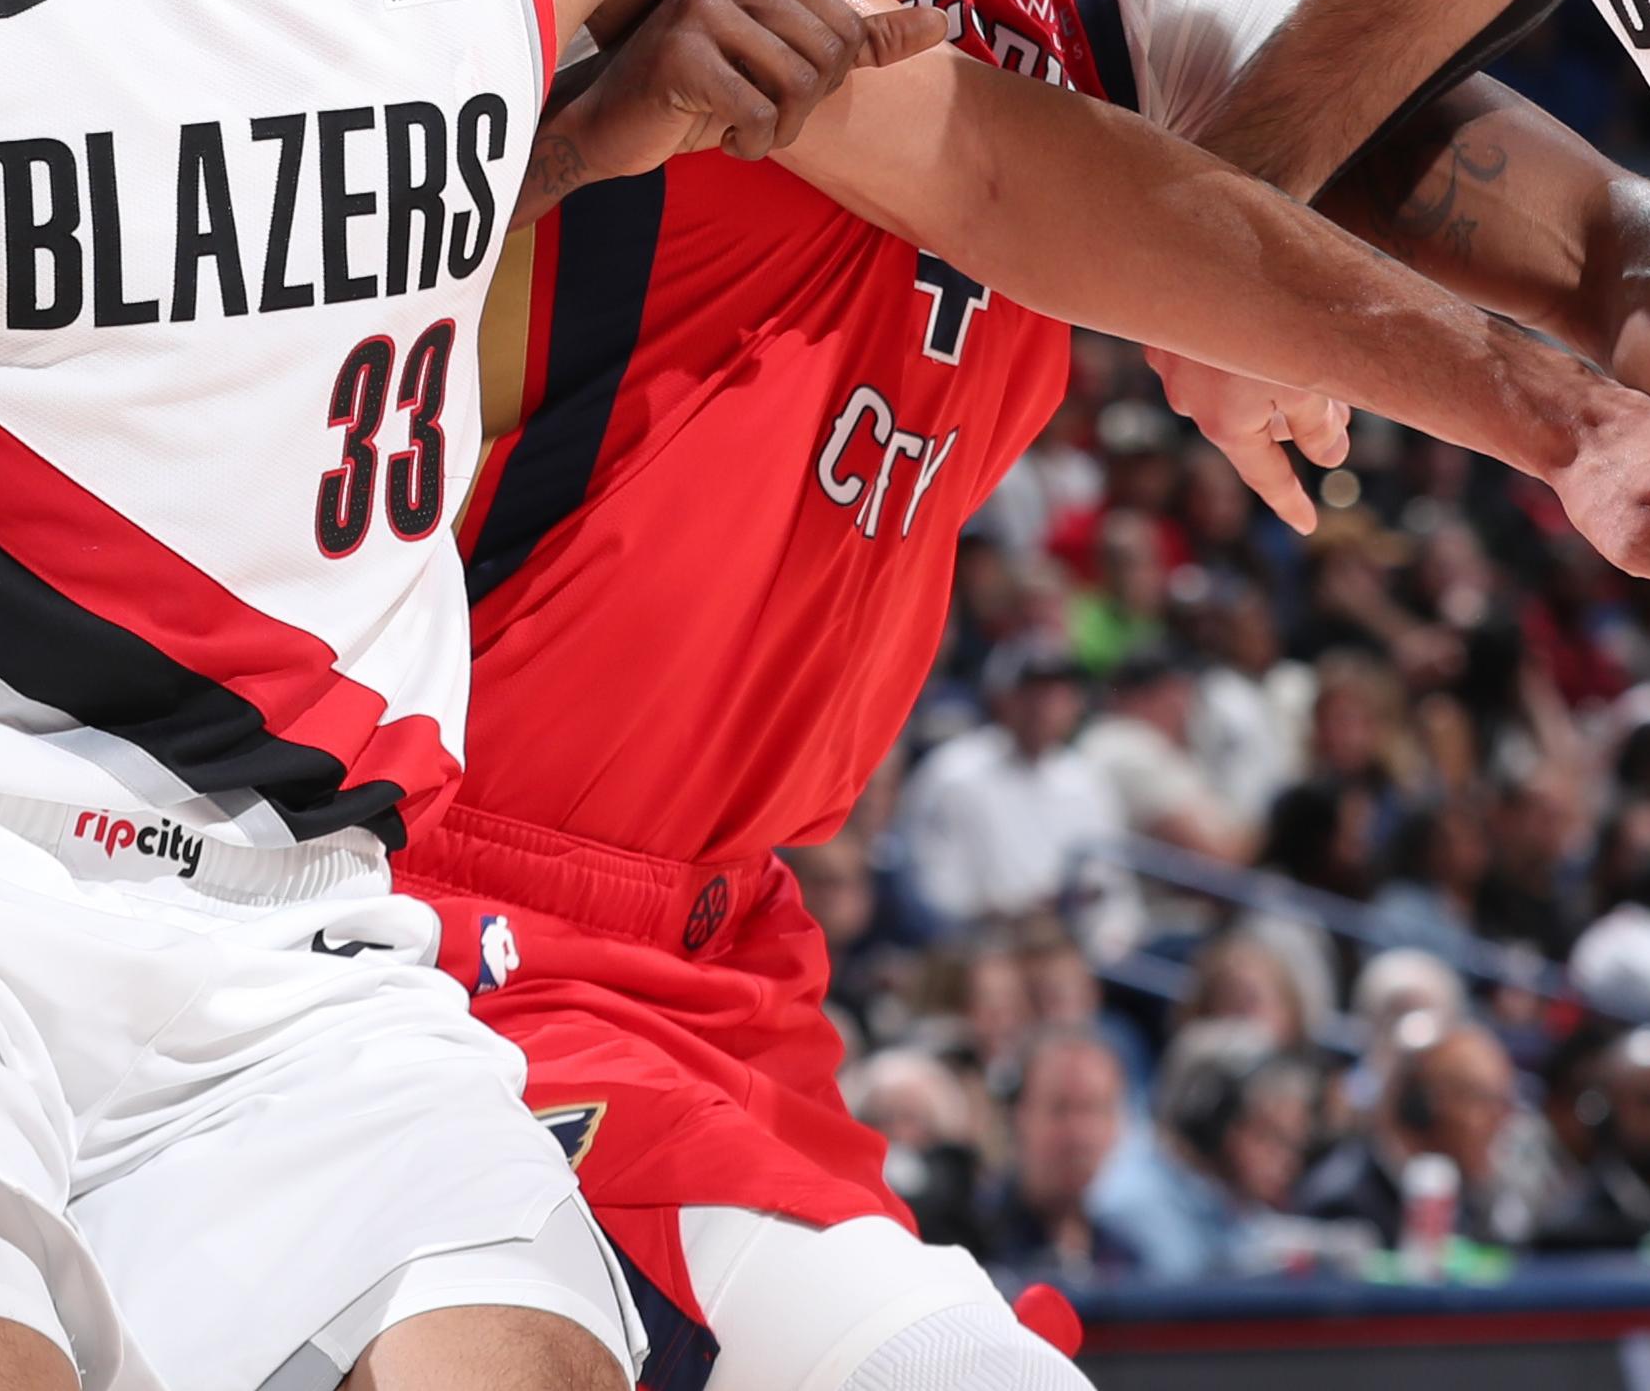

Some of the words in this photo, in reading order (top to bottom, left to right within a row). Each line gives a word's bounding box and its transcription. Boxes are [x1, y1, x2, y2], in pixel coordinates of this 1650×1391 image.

[315, 318, 456, 560] 33
[818, 384, 960, 539] CTY
[74, 809, 204, 879] ripcity
